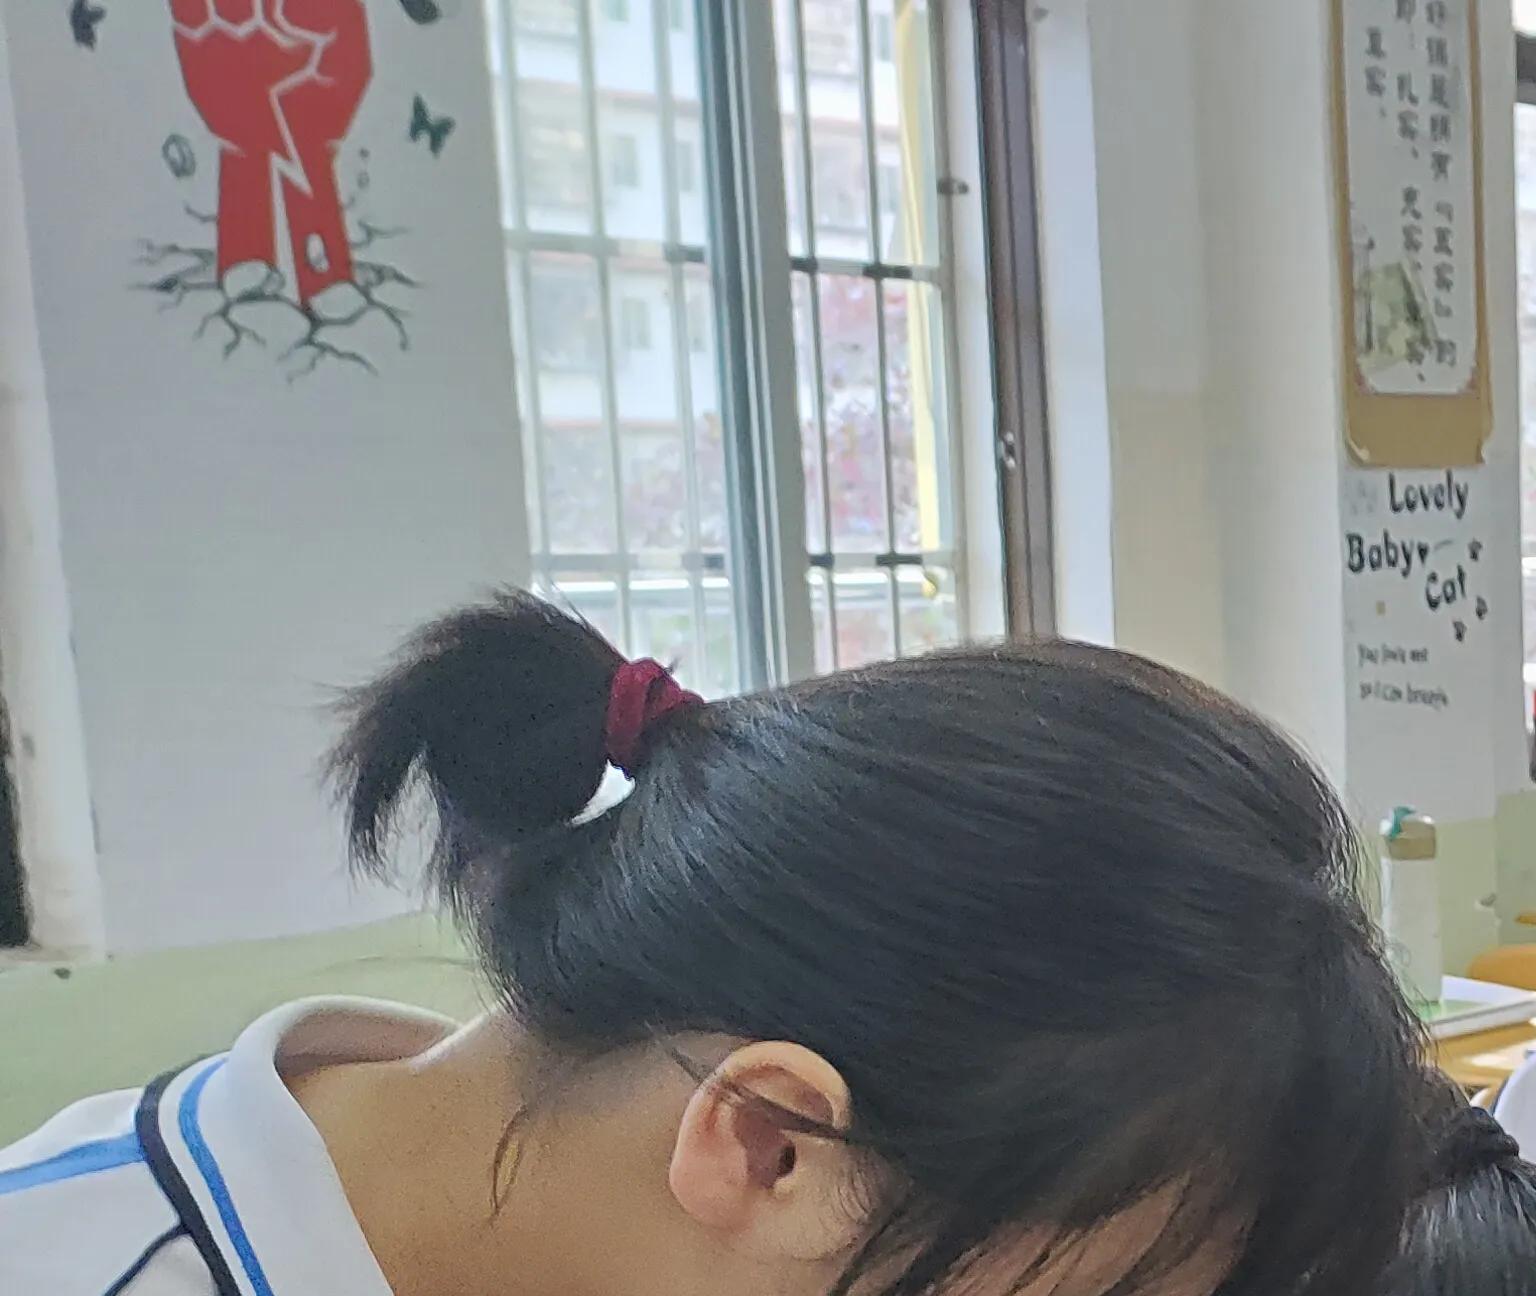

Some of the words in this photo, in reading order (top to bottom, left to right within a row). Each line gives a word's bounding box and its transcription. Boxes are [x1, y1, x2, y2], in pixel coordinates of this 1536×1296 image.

[1388, 469, 1469, 520] Lovely
[1347, 529, 1415, 579] Baby
[1426, 564, 1467, 612] Cat
